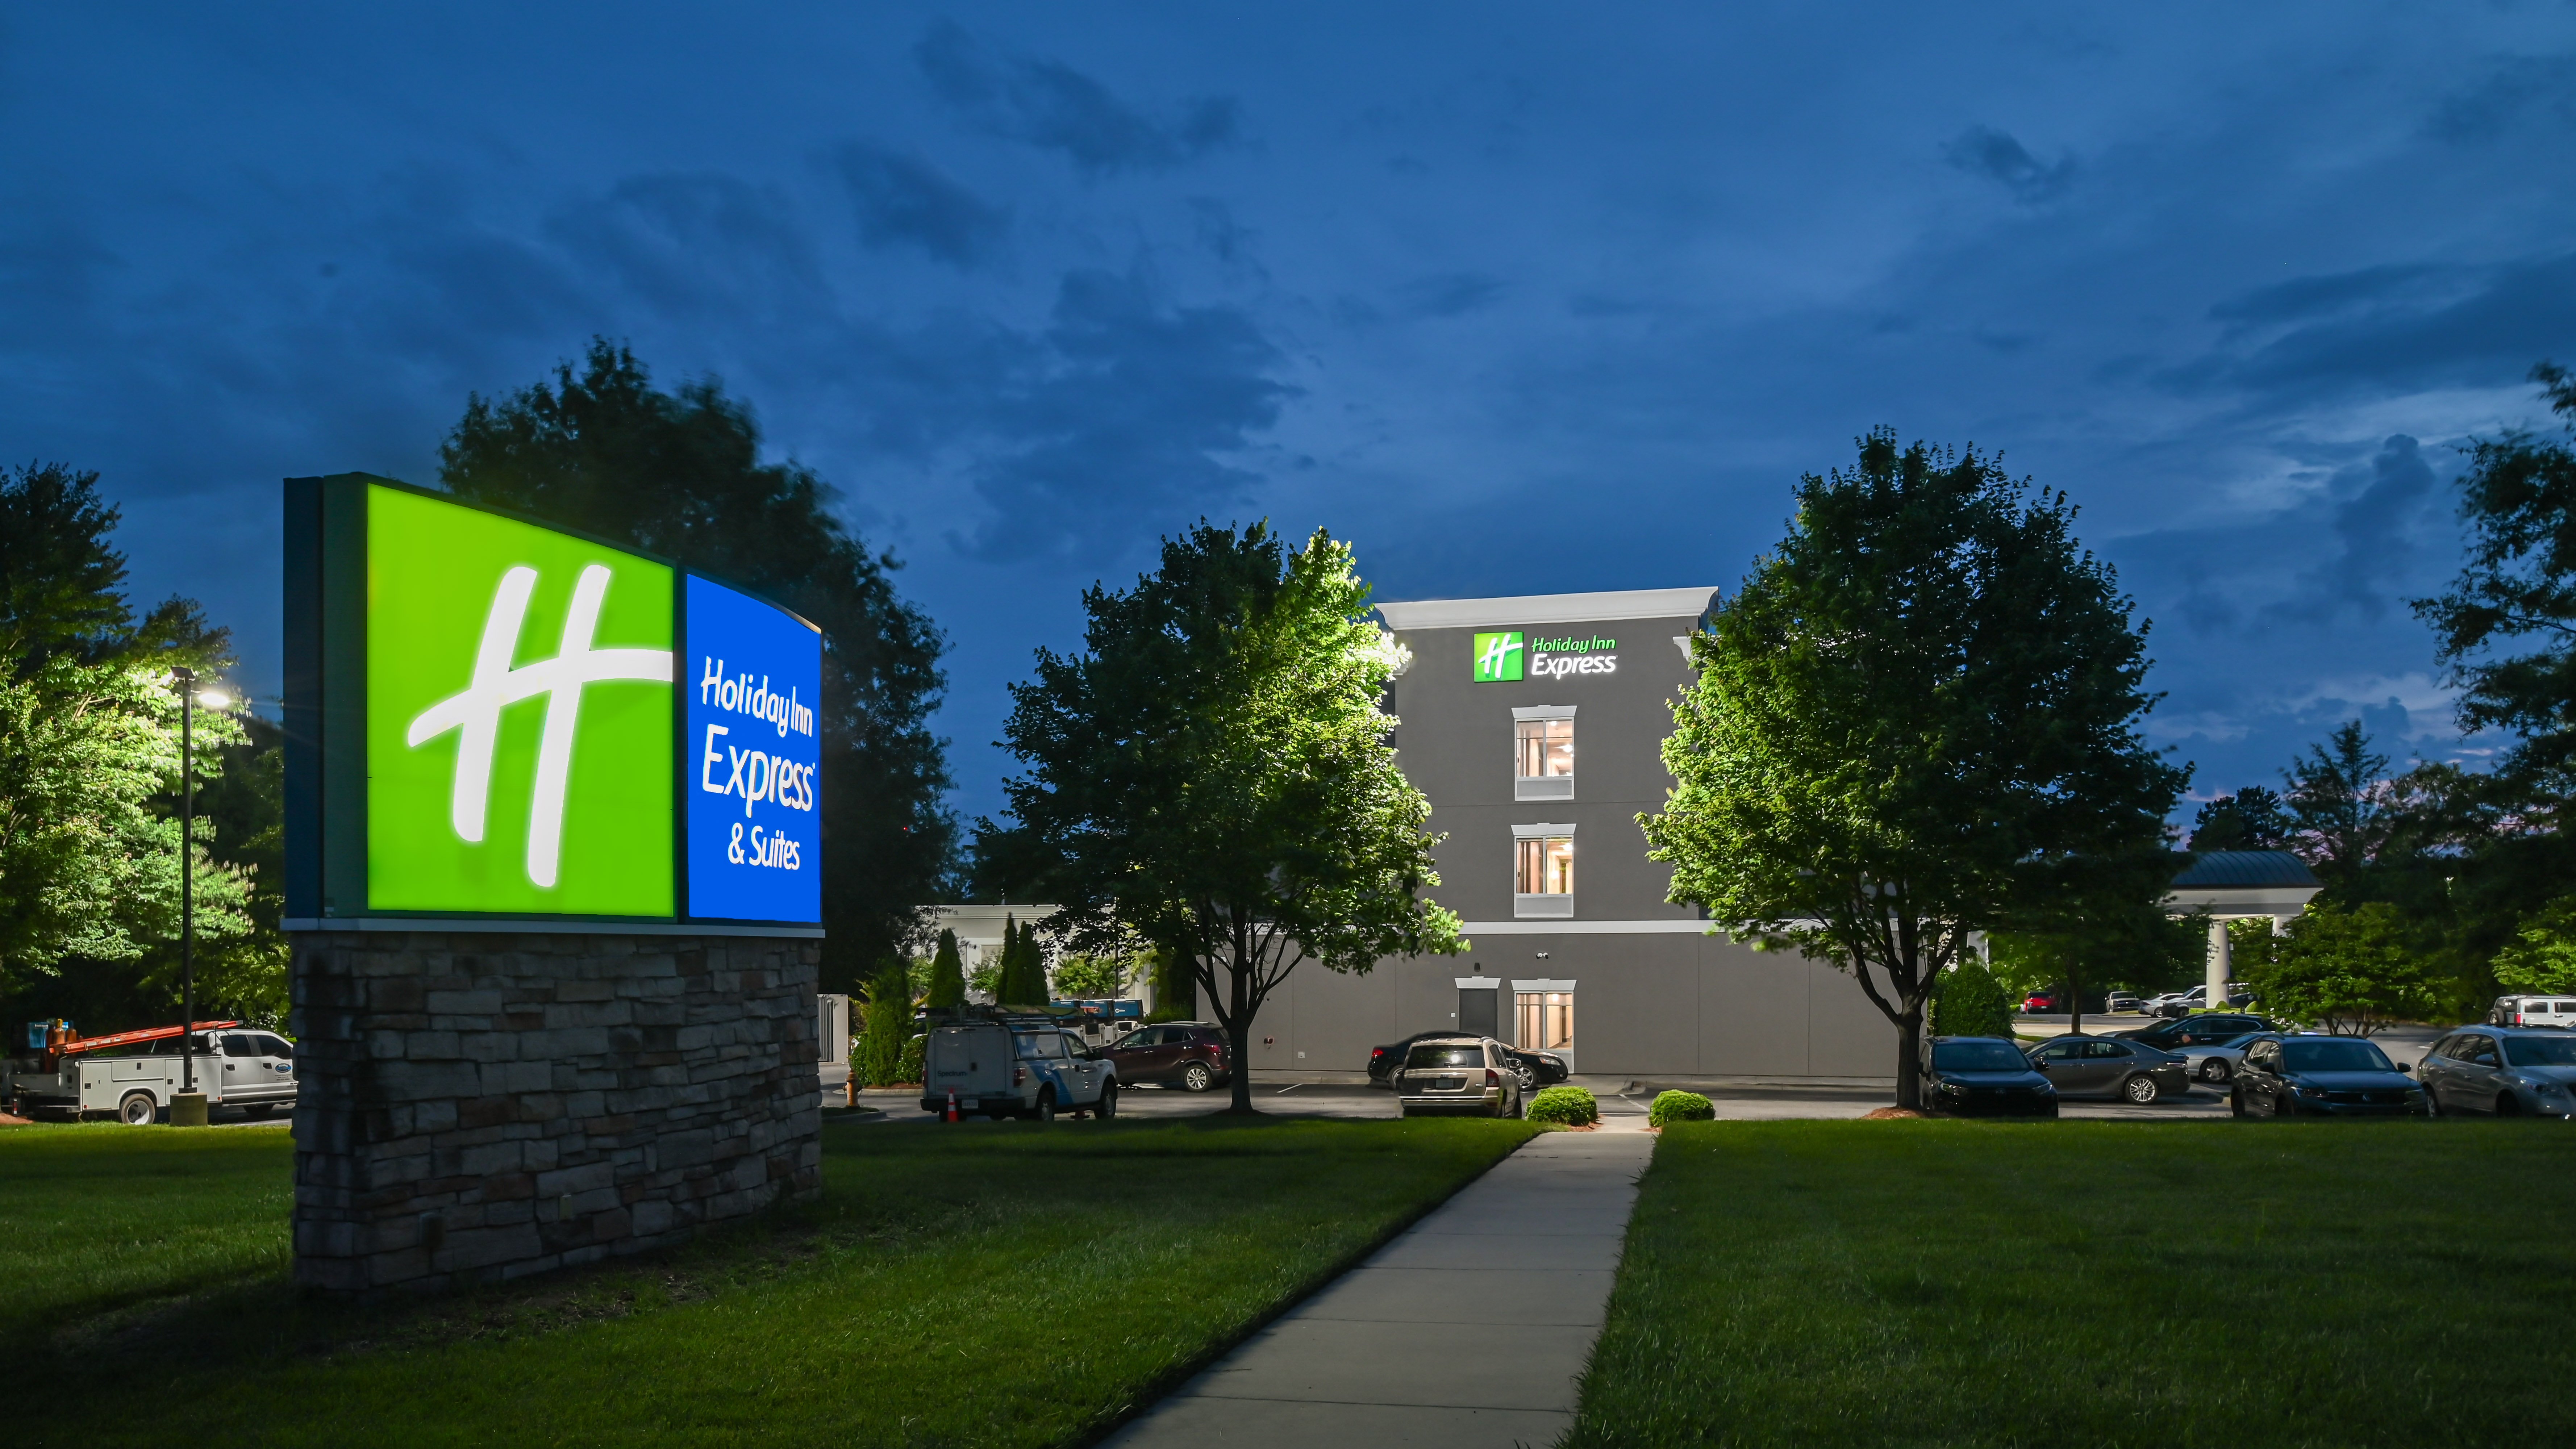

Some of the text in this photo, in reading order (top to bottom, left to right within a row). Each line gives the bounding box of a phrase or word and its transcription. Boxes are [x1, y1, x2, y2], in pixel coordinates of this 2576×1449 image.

[1531, 635, 1616, 654] Holiday Inn
[1531, 653, 1617, 680] Express
[701, 656, 812, 738] Holiday Inn
[702, 723, 813, 818] Express
[728, 822, 800, 870] & Suites
